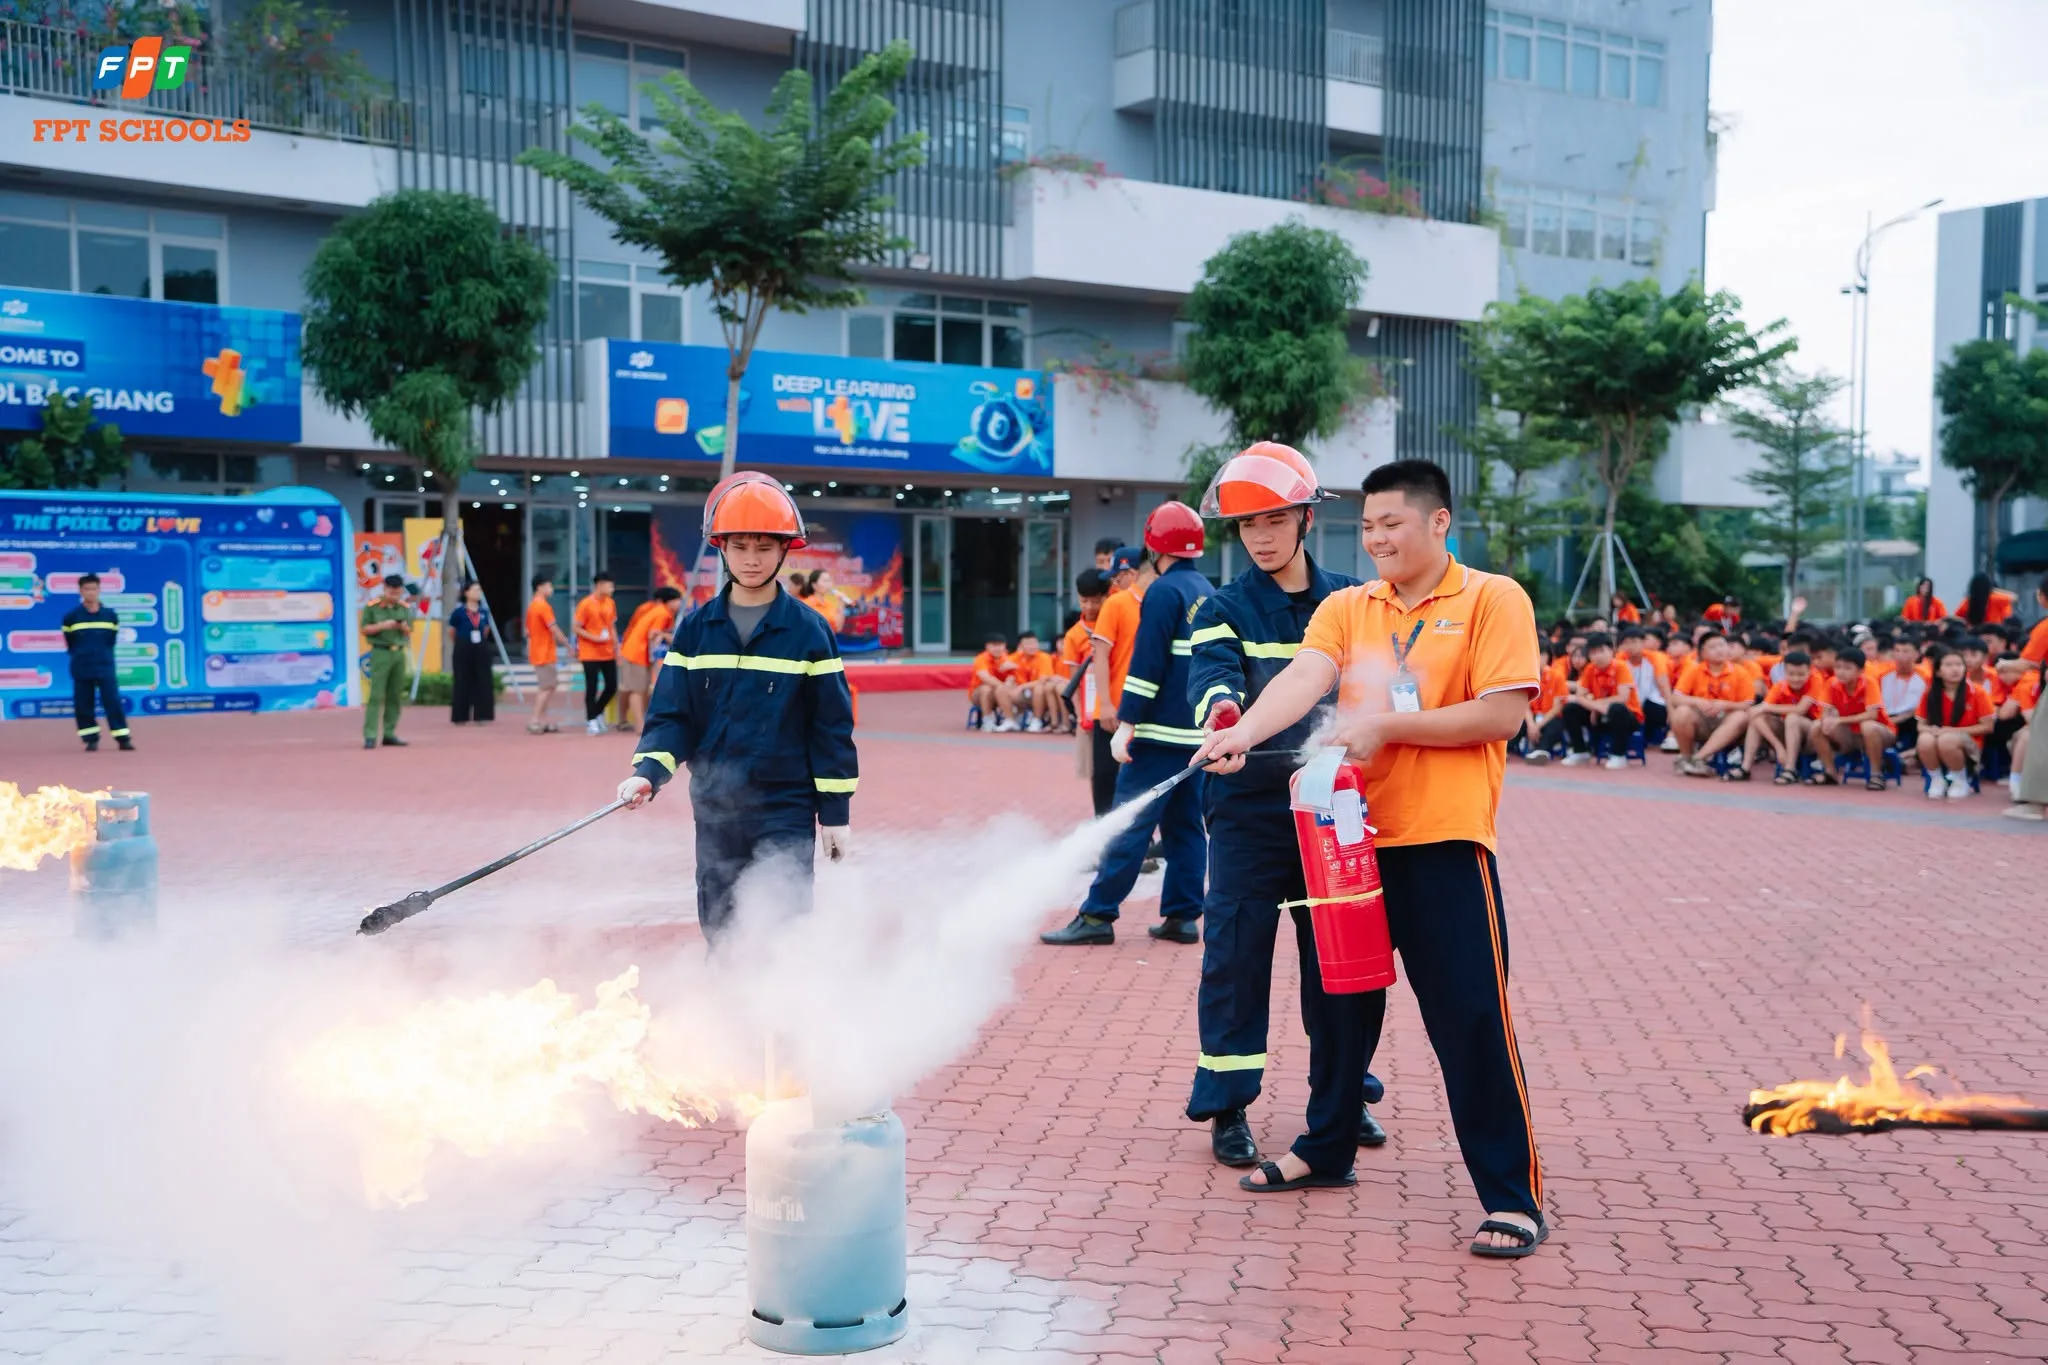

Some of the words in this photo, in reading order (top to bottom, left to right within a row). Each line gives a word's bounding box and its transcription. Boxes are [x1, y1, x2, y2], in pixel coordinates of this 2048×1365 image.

[50, 351, 79, 367] TO
[772, 374, 823, 393] DEEP
[824, 379, 916, 400] LEARNING
[86, 388, 174, 413] GIANG
[813, 397, 910, 443] LVE
[13, 514, 52, 531] THE
[56, 514, 113, 532] PIXEL
[118, 517, 144, 532] OF
[146, 517, 201, 533] LVE
